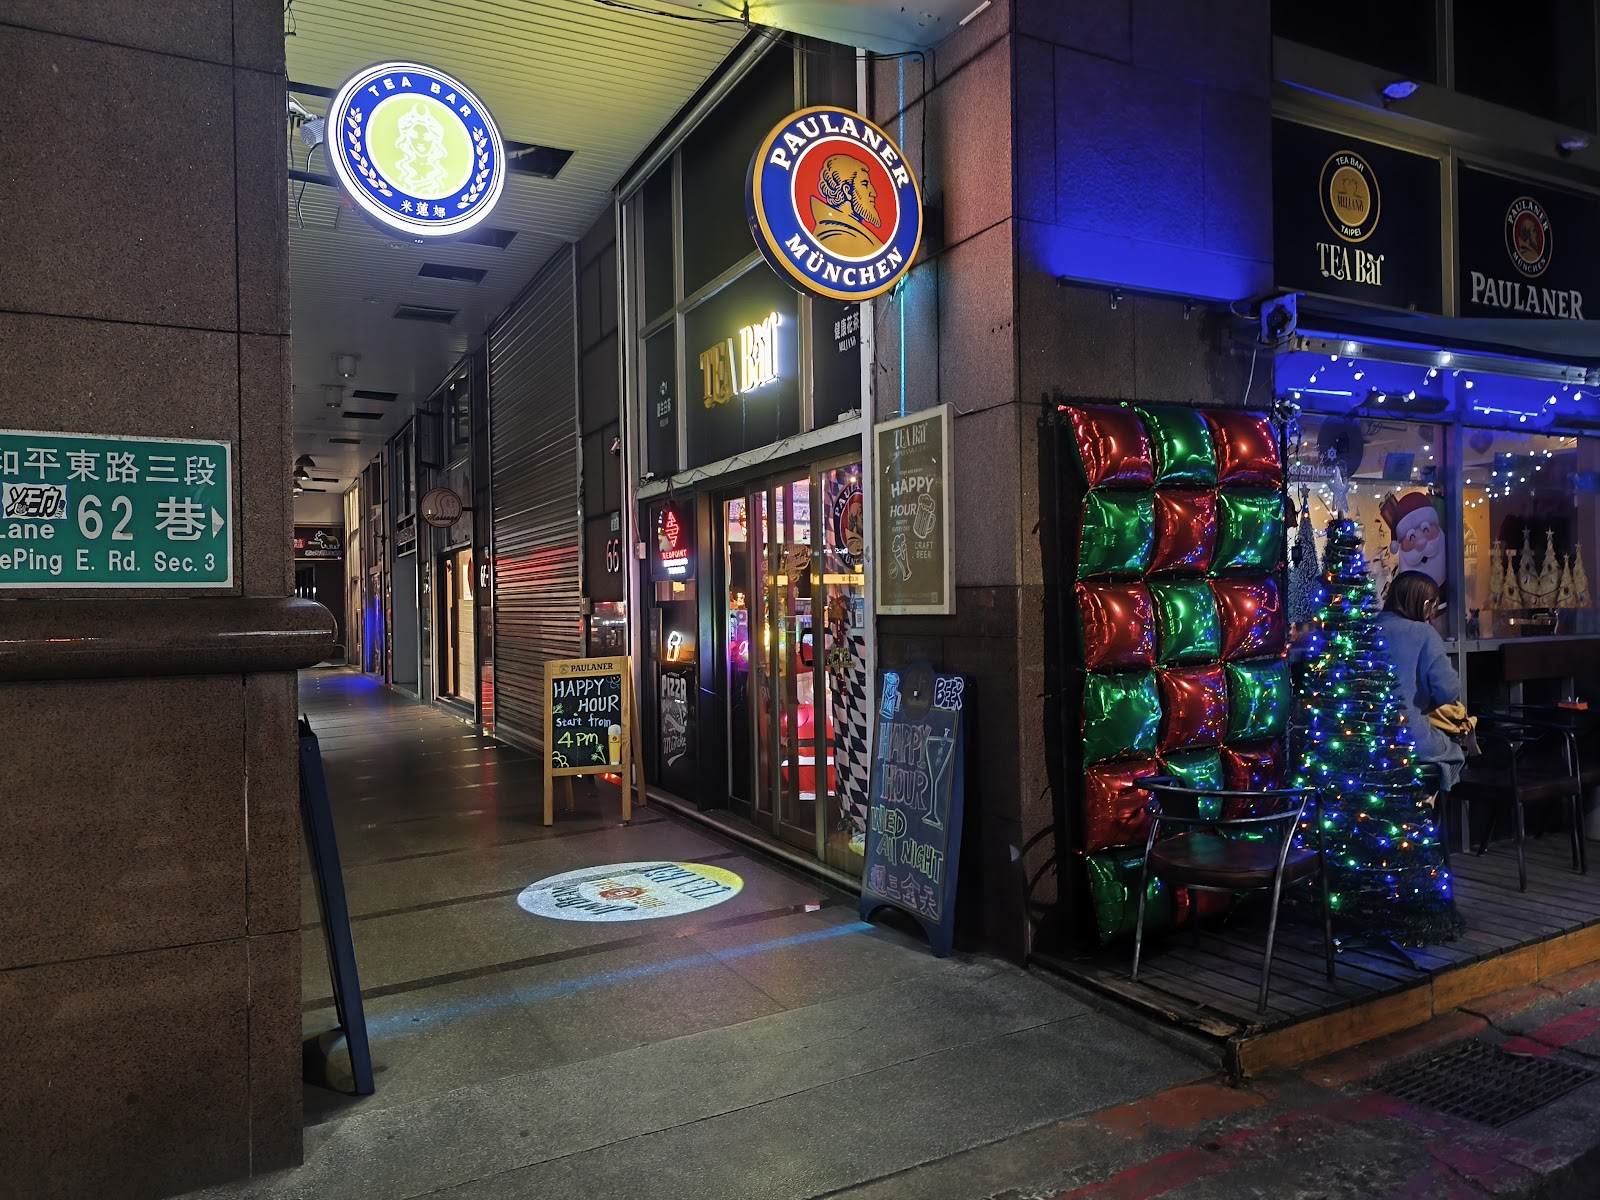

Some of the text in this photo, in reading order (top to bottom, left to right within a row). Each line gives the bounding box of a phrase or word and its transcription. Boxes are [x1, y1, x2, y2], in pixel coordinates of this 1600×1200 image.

[368, 76, 472, 117] TEA BAR
[770, 114, 909, 188] PAULANER
[1336, 155, 1365, 172] TEA BAR
[1340, 224, 1362, 237] TAIPEI
[1507, 200, 1549, 232] PAULANER
[785, 233, 903, 286] MÜNCHEN
[1316, 242, 1352, 281] TEA
[1470, 271, 1585, 320] PAULANER
[834, 311, 860, 341] 健康花茶
[891, 476, 934, 498] HAPPY
[77, 494, 134, 541] 62
[155, 496, 206, 541] 巷
[890, 503, 917, 518] HOUR
[76, 549, 95, 571] E.
[109, 550, 141, 572] Rd.
[154, 553, 198, 572] Sec.
[204, 553, 216, 572] 3
[606, 539, 620, 573] 66
[914, 541, 934, 550] CRAFT
[916, 550, 932, 559] BEER
[571, 663, 614, 672] PAULANER
[554, 679, 605, 698] HAPPY
[577, 694, 620, 713] HOUR
[662, 675, 687, 701] PIZZA
[934, 677, 964, 711] BEER
[588, 713, 612, 728] from
[557, 731, 574, 748] 4
[878, 722, 932, 769] HAPPY
[880, 763, 929, 811] HOUR
[871, 804, 908, 839] WED
[876, 833, 944, 884] AT NIGHT
